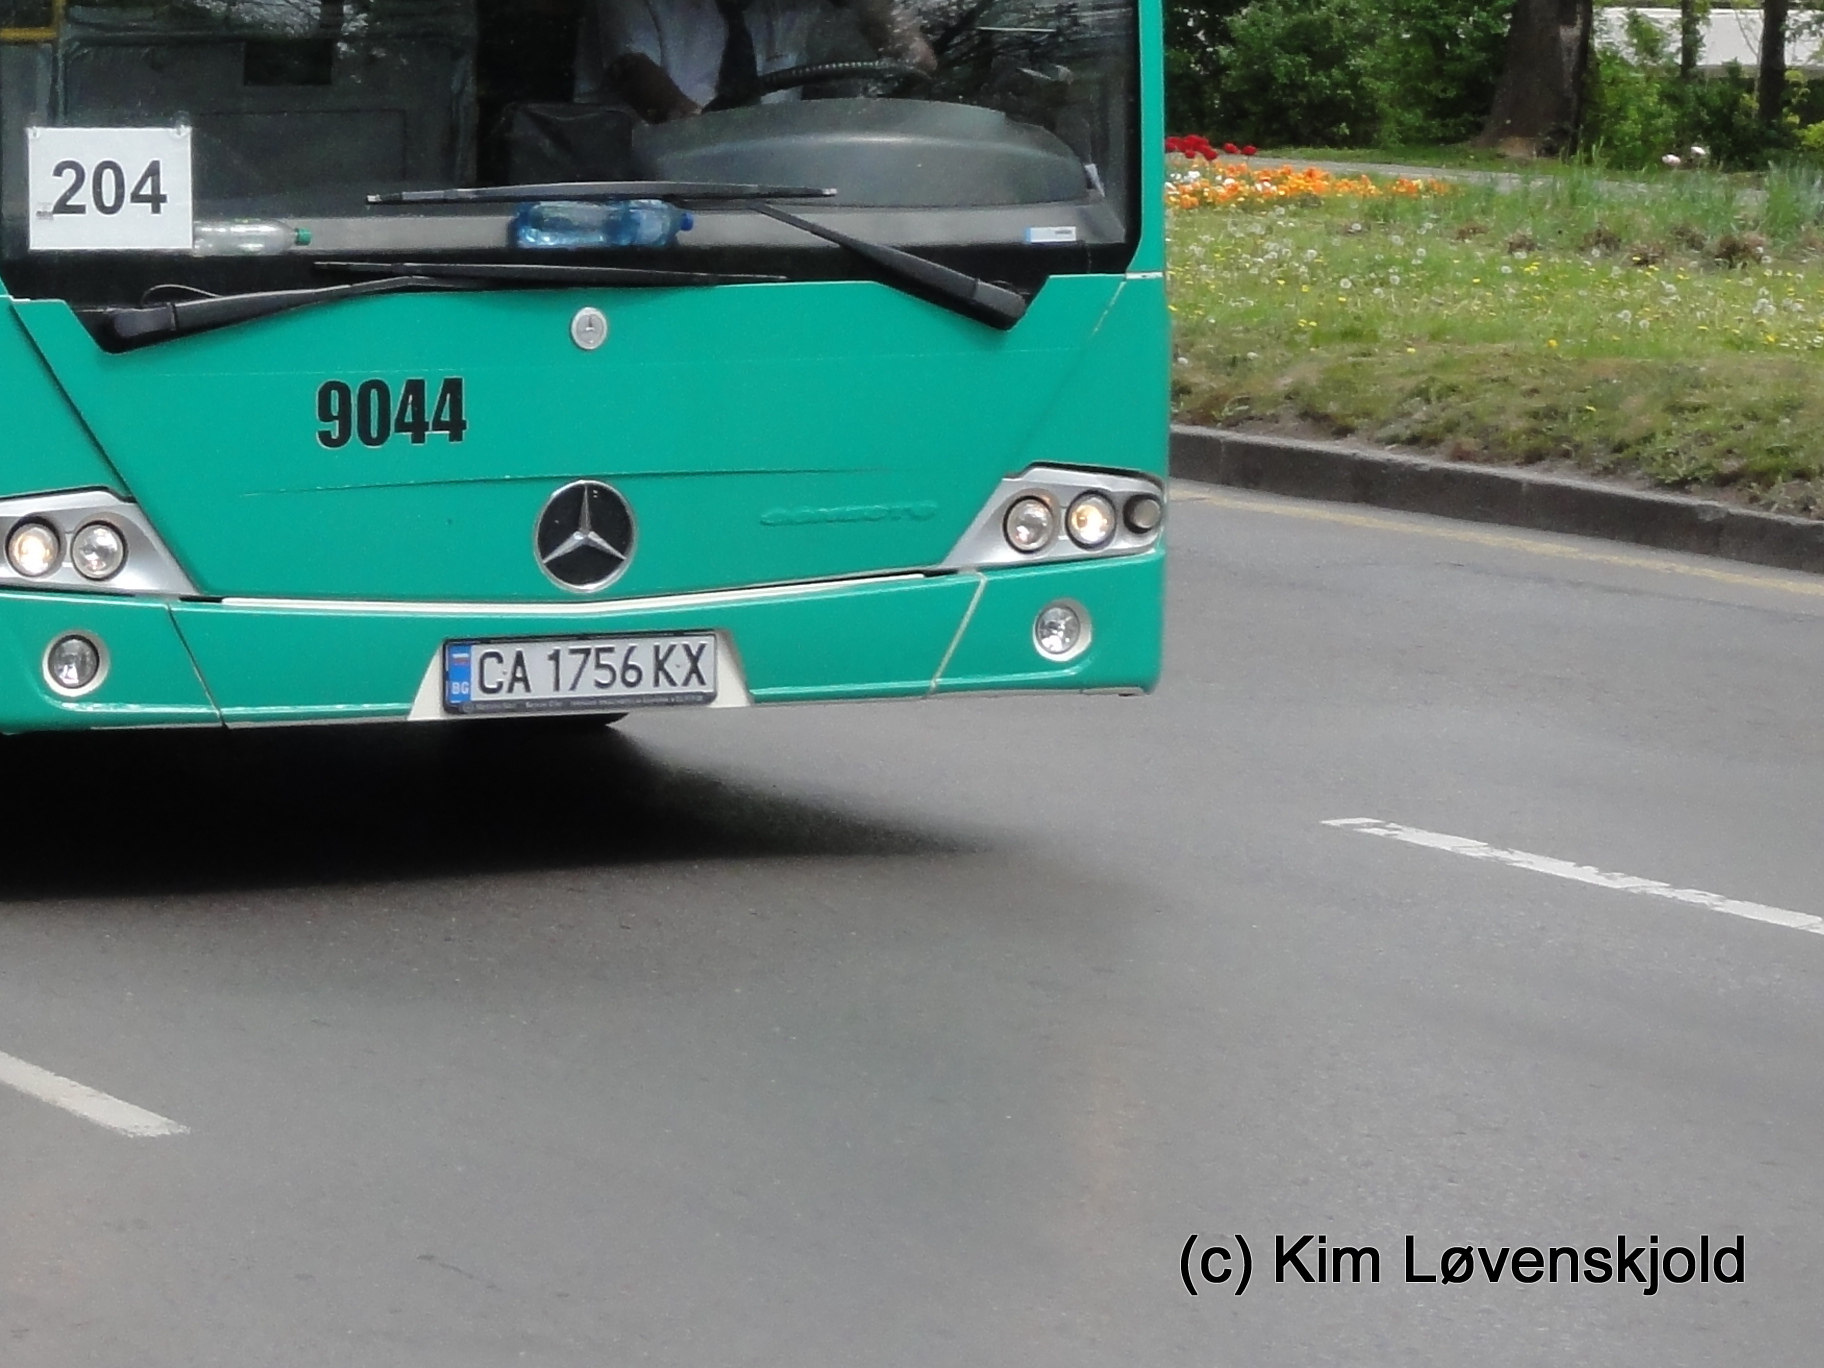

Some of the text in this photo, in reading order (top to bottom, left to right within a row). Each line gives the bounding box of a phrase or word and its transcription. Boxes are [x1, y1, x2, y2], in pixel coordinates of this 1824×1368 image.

[52, 160, 168, 215] 204
[315, 376, 468, 449] 9044
[451, 682, 470, 695] BG
[478, 643, 707, 695] CA 1756 KX
